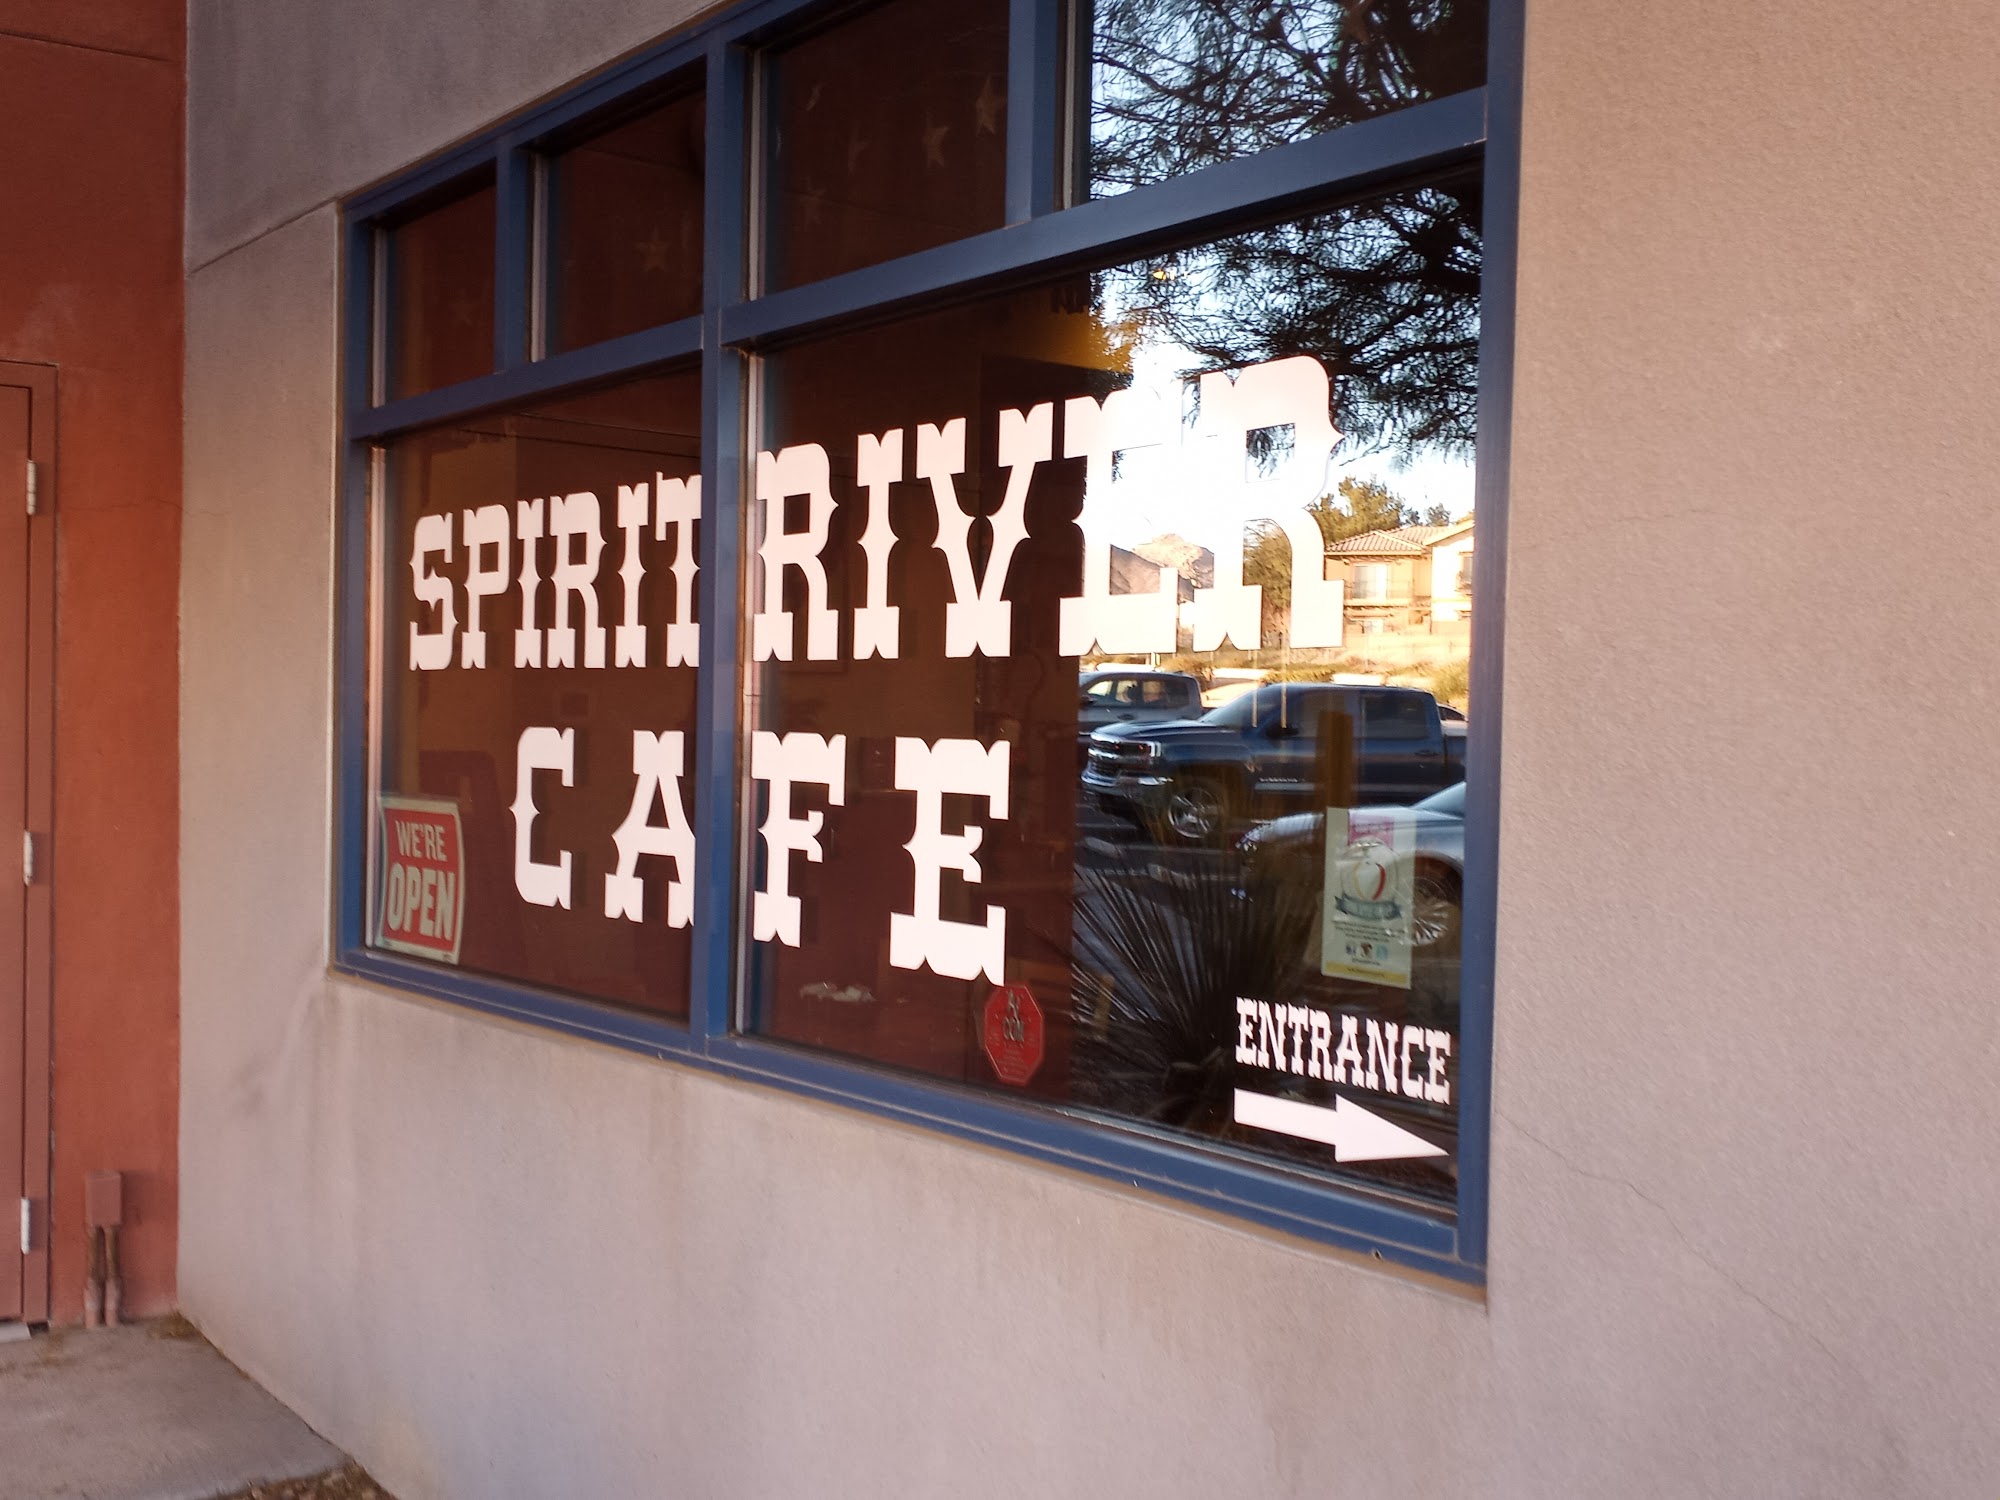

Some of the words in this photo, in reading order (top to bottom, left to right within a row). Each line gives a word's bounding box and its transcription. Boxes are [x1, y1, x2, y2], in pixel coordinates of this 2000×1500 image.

[409, 471, 702, 671] SPIRIT
[753, 355, 1345, 662] RIVER
[395, 820, 448, 862] WE'RE
[509, 726, 1011, 986] CAFE
[387, 863, 455, 939] OPEN
[1235, 996, 1451, 1105] ENTRANCE
